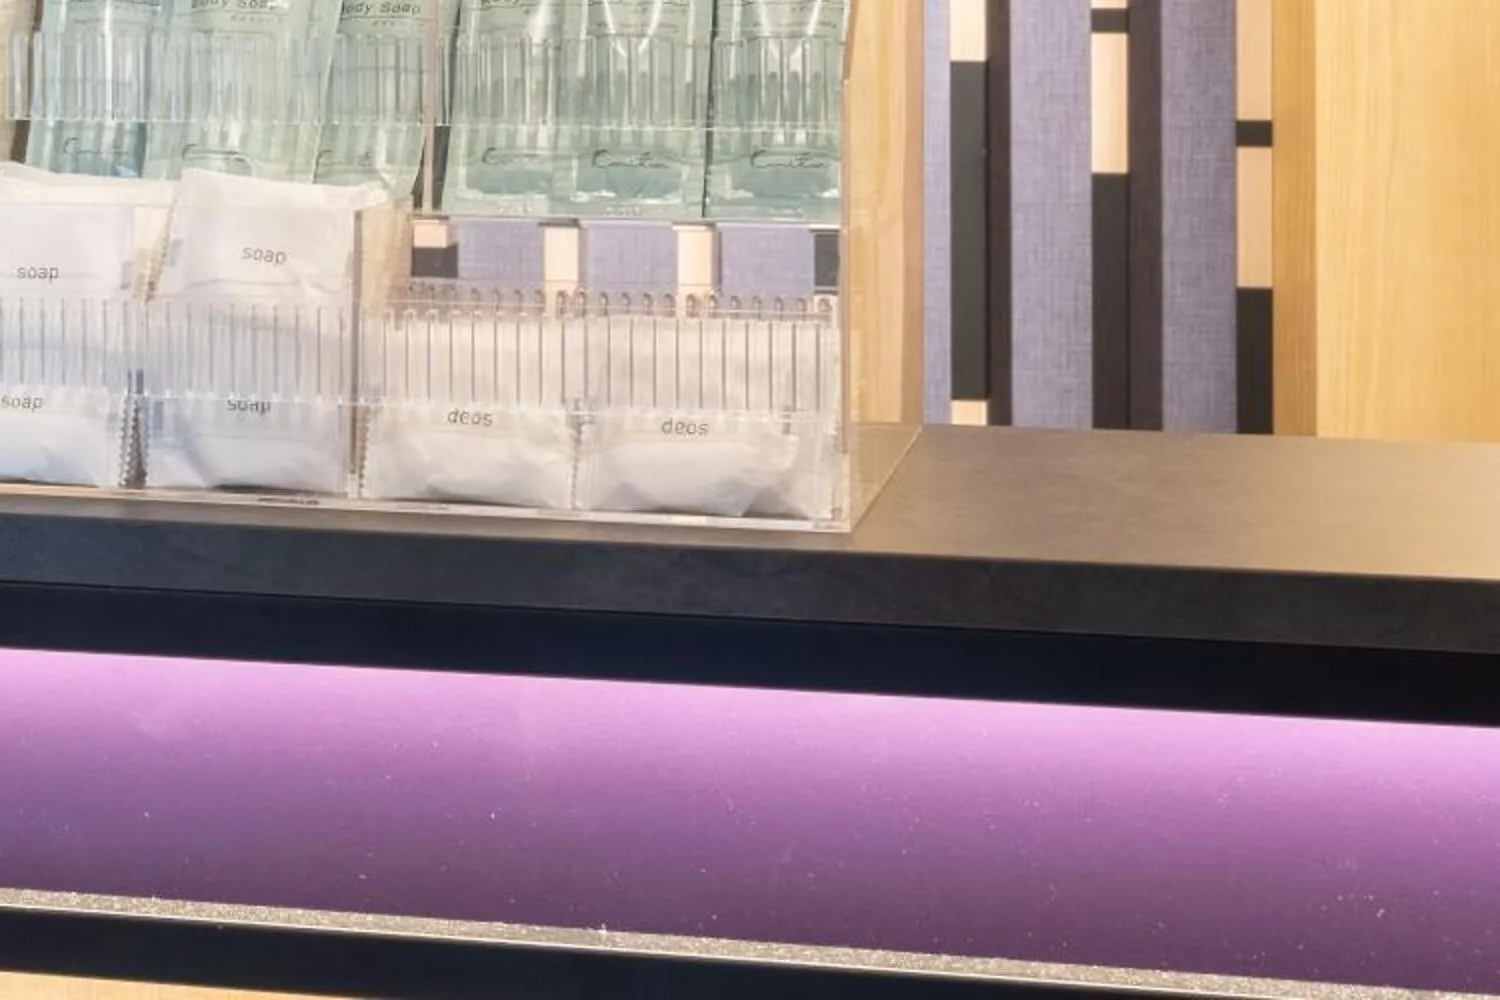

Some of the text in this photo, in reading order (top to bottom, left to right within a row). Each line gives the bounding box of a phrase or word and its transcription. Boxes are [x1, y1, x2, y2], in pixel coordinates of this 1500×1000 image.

[242, 246, 287, 266] soap
[17, 265, 60, 282] soap
[1, 393, 43, 412] soap
